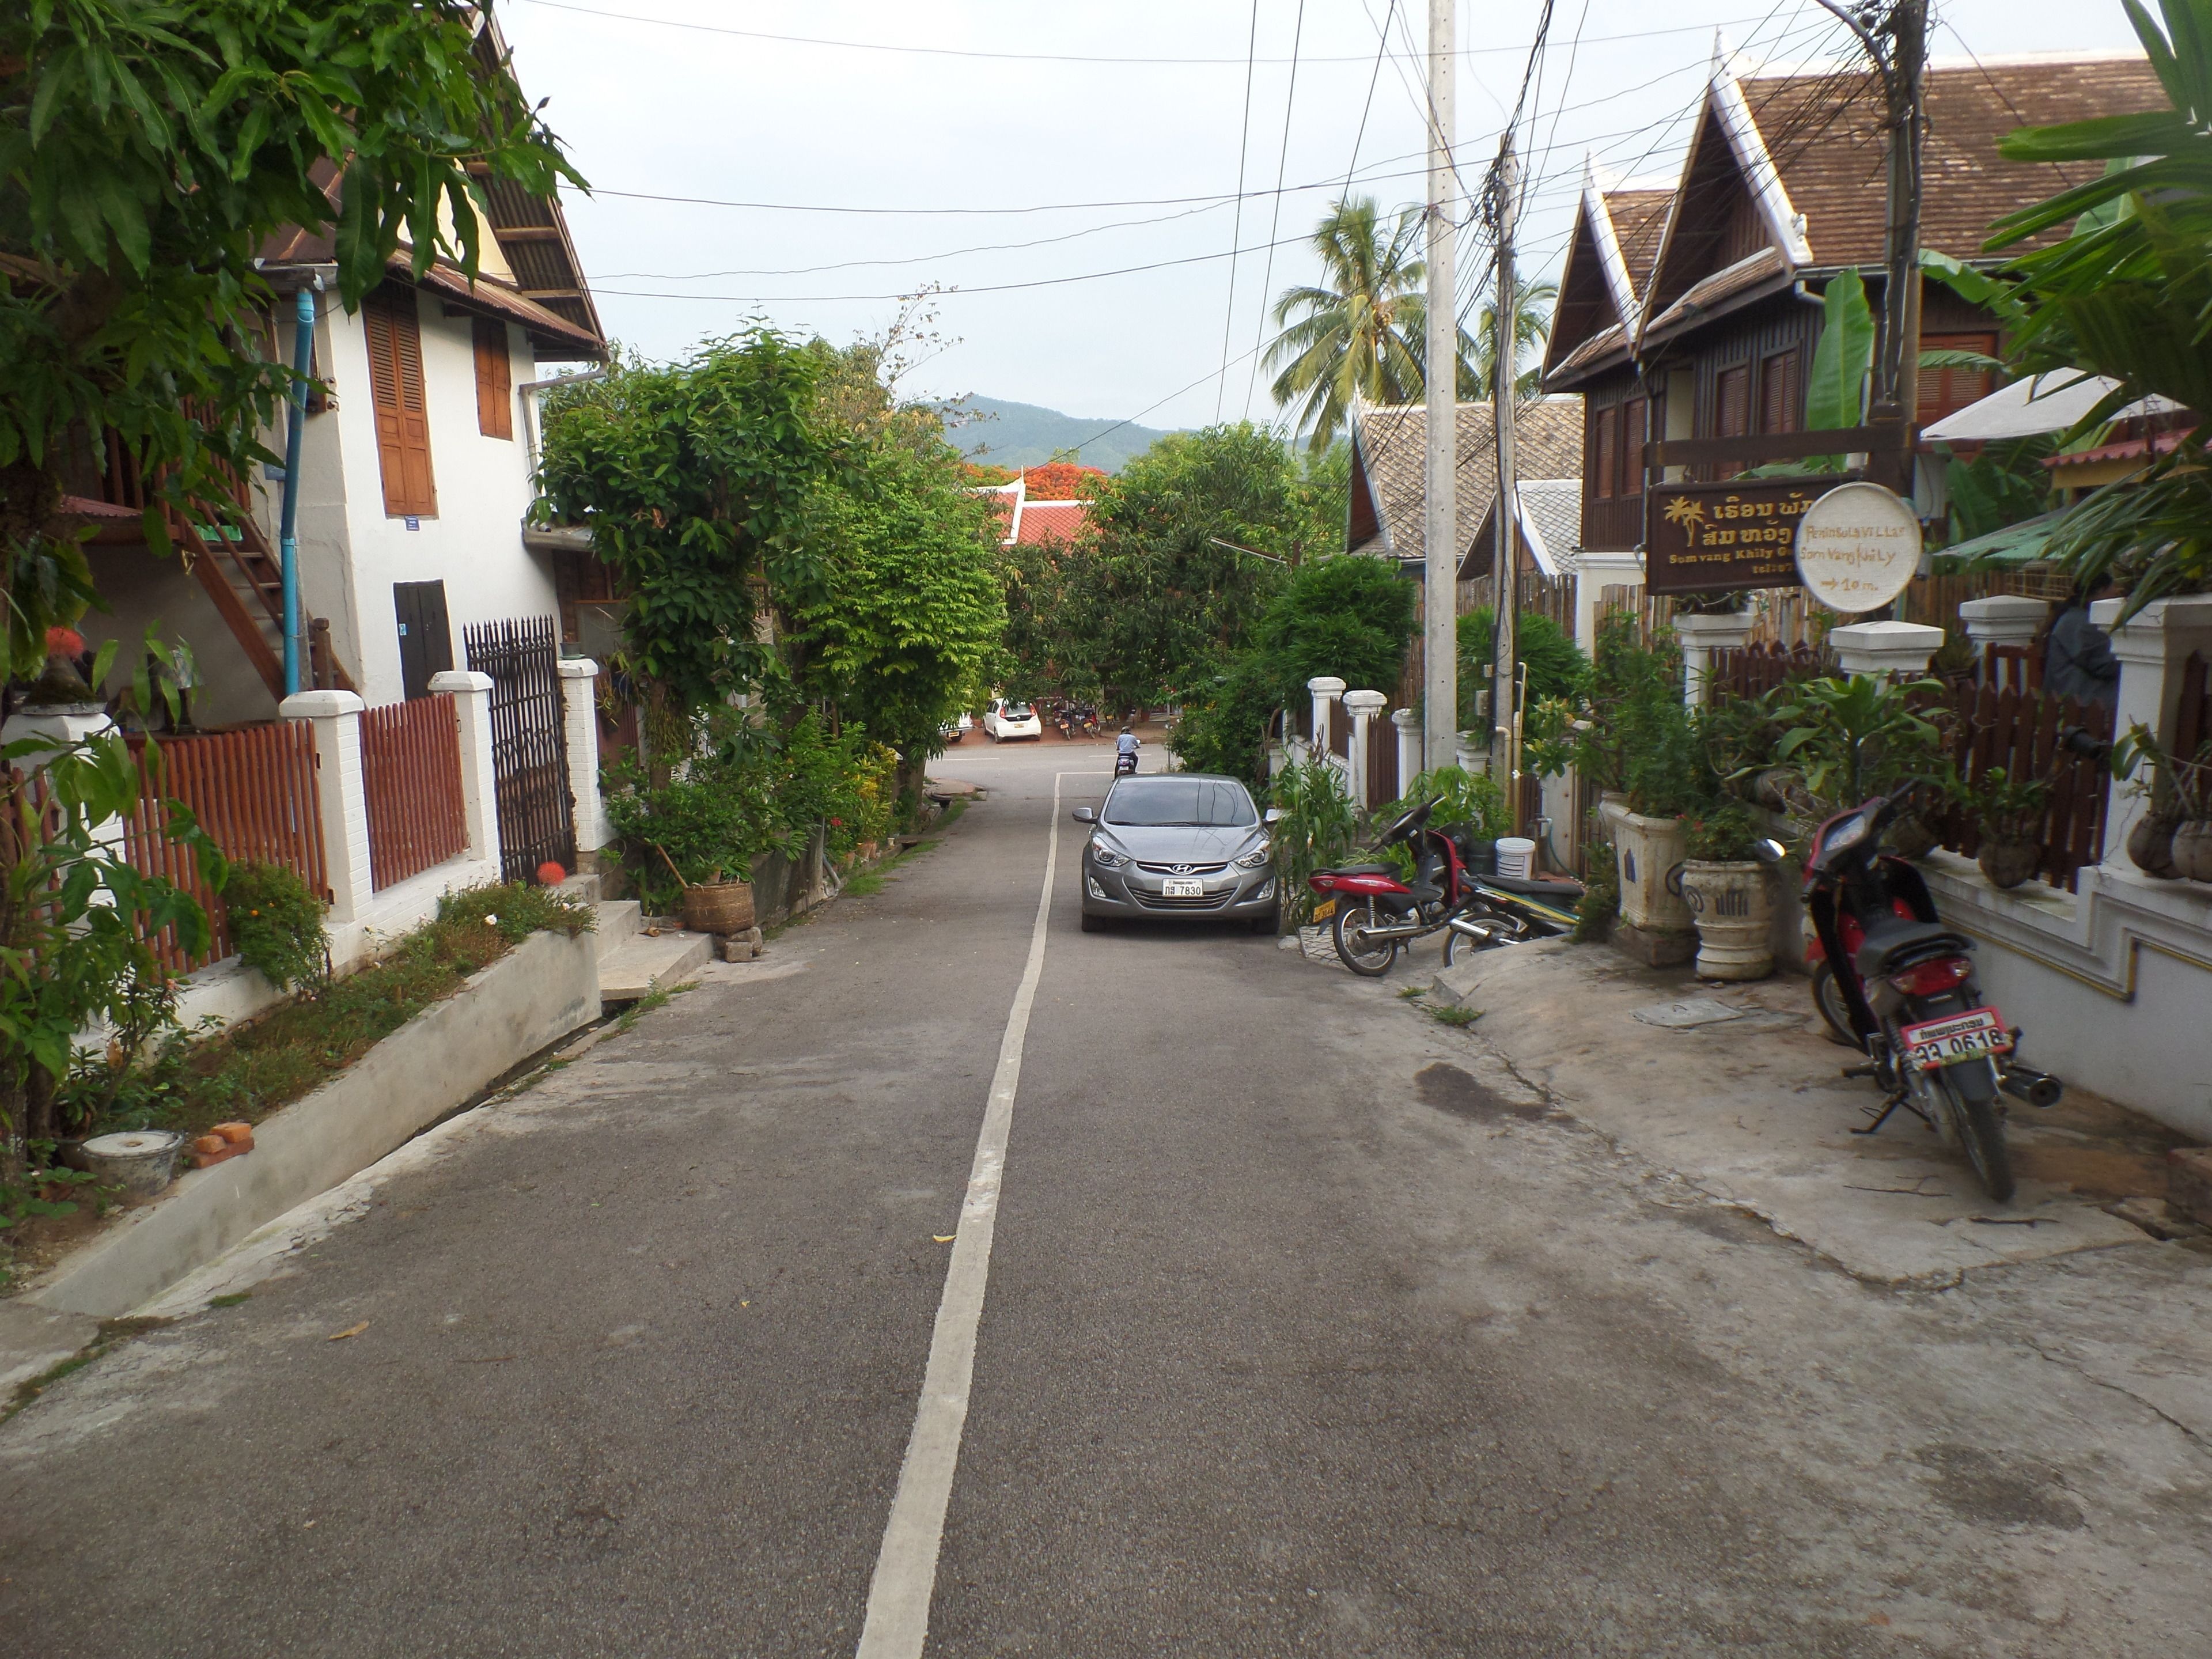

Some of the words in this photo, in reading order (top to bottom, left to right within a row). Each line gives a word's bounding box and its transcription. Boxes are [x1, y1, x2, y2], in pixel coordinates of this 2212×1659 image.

[1735, 548, 1774, 559] Khily
[1840, 578, 1859, 591] 10
[1180, 886, 1201, 895] 7830
[1950, 1028, 2003, 1055] 0618
